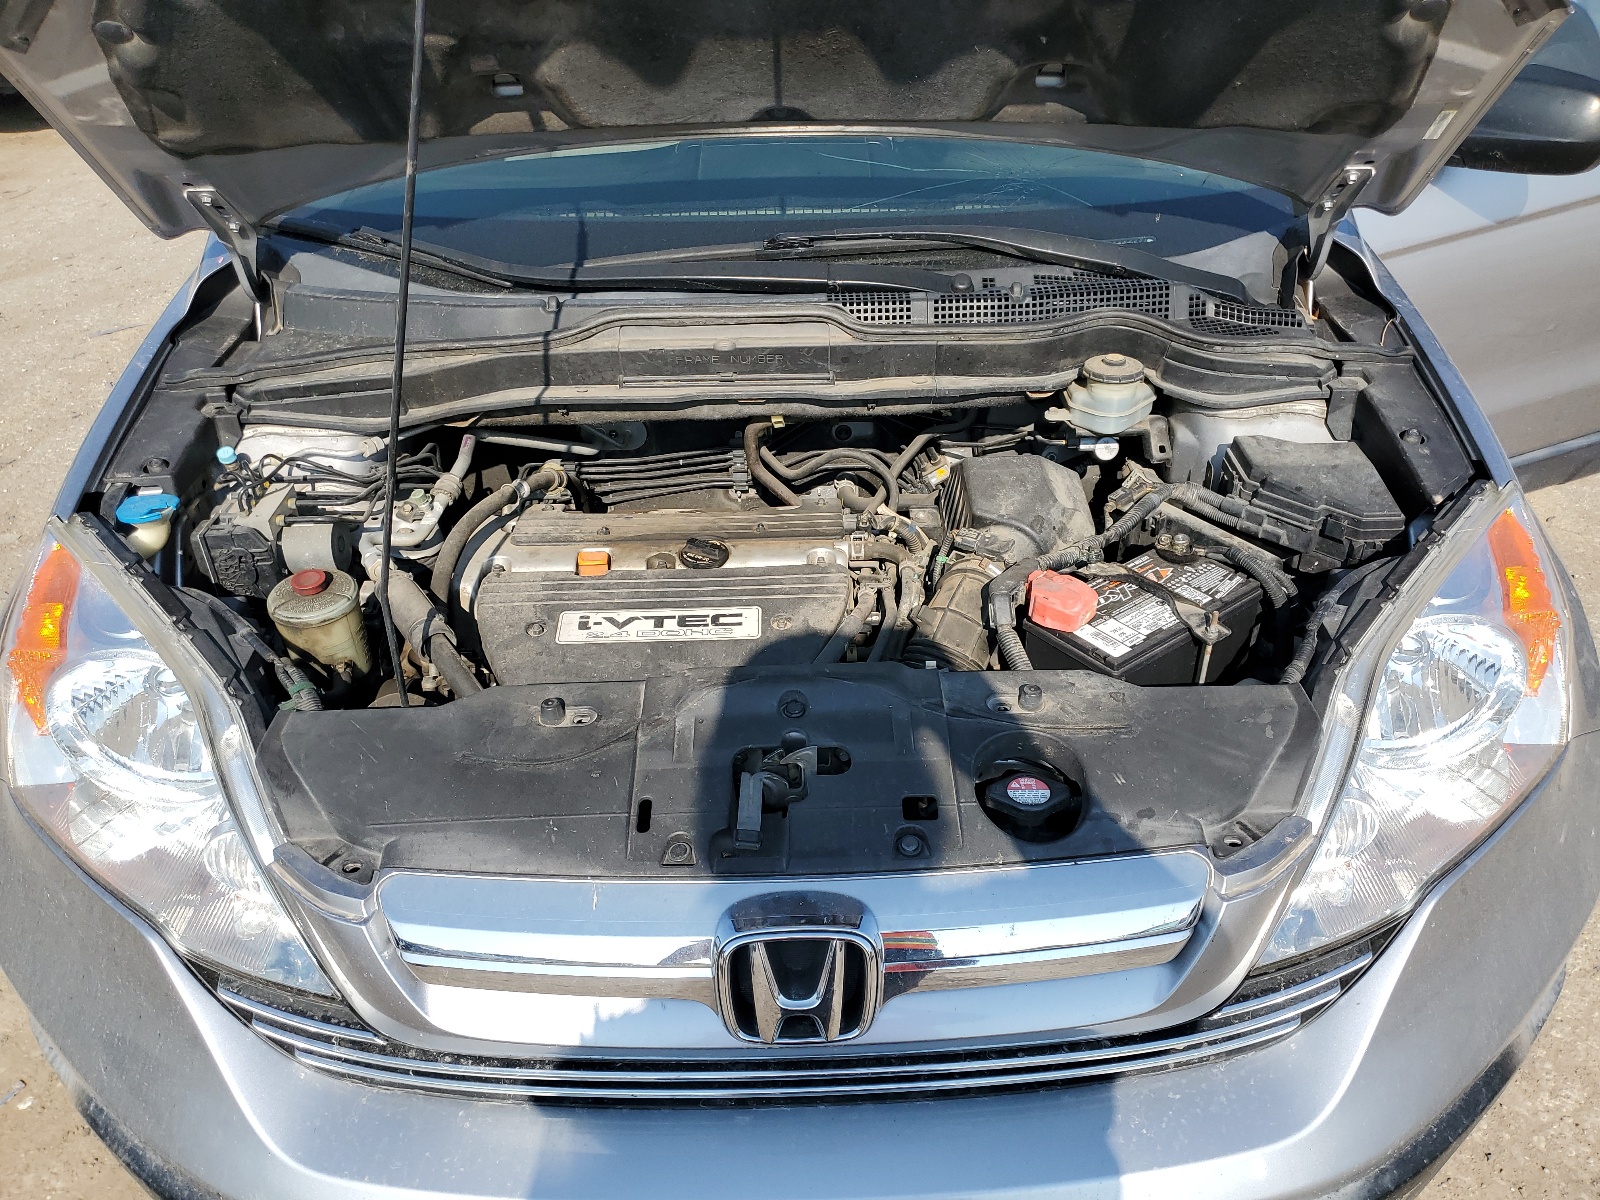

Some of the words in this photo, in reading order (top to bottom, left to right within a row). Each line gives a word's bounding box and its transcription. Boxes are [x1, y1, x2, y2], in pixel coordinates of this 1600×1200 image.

[675, 355, 720, 365] FRAME
[730, 354, 784, 365] NUMBER
[577, 612, 743, 631] i-VTEC
[586, 630, 631, 639] 2.4
[636, 628, 734, 638] DOHC
